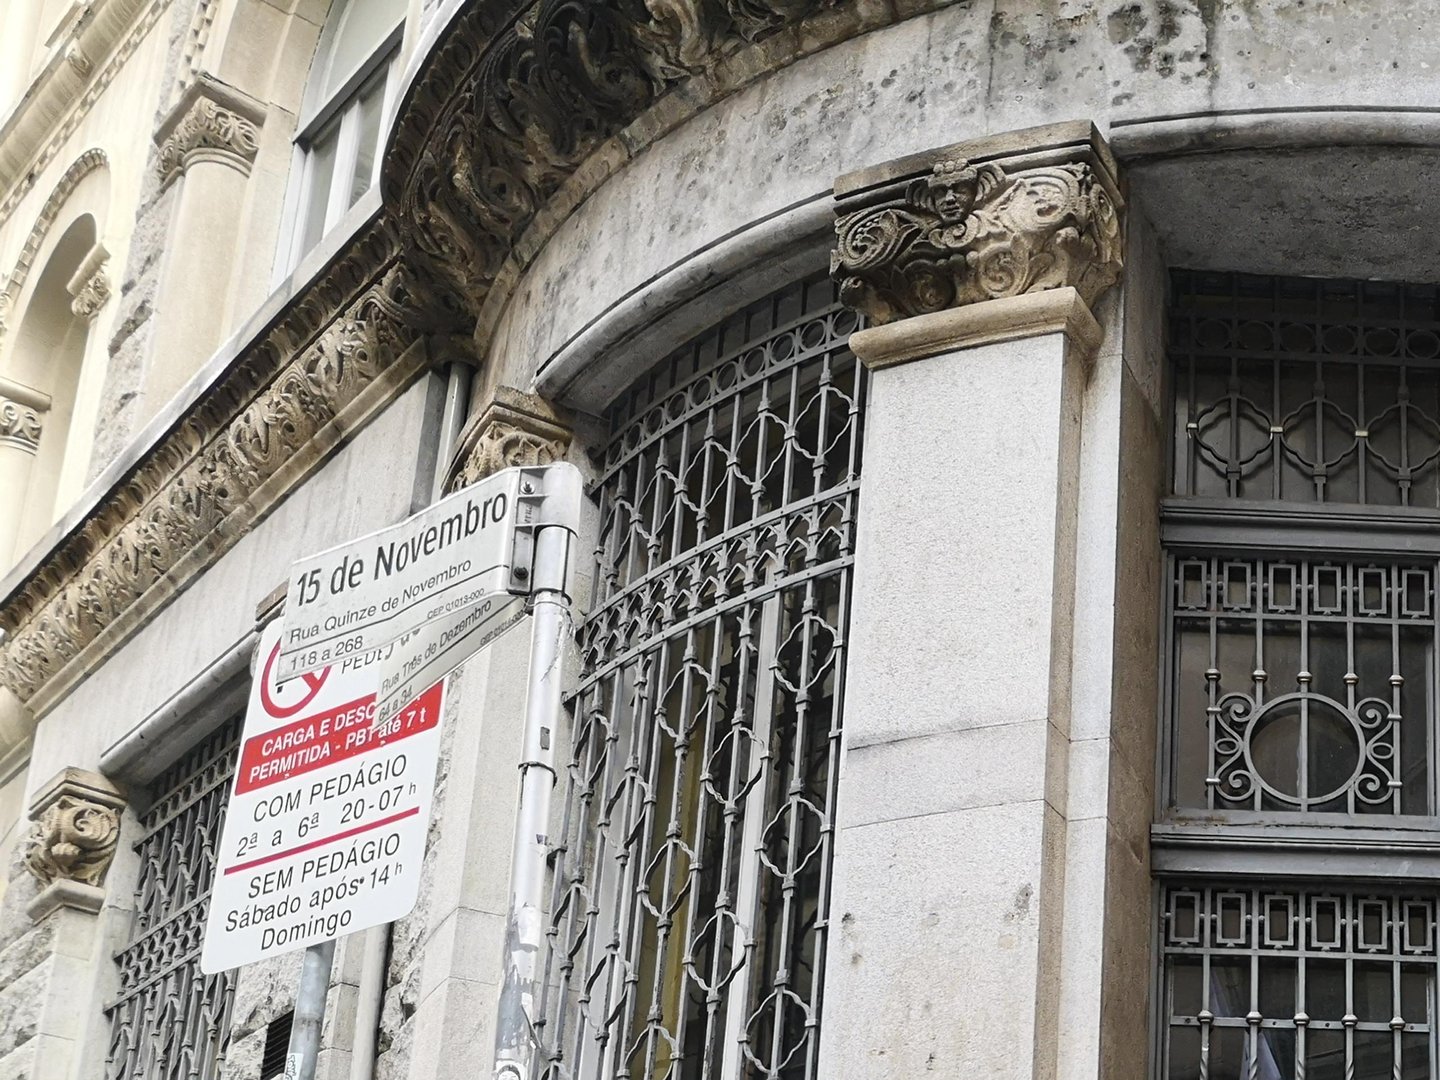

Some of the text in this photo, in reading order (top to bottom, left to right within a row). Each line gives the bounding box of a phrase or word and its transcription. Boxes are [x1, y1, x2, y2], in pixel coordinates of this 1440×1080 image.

[297, 568, 322, 607] 15
[330, 555, 364, 595] de
[373, 492, 507, 581] Novembro
[289, 559, 472, 645] Rua Quinze de Novembro
[427, 605, 444, 621] CEP
[290, 650, 317, 671] 118
[321, 650, 331, 661] a
[335, 635, 363, 657] 268
[381, 672, 400, 695] Rua
[402, 654, 423, 677] Três
[424, 642, 437, 660] de
[439, 600, 492, 649] Dezembro
[261, 722, 316, 757] CARGA
[319, 718, 331, 737] E
[378, 702, 391, 722] 64
[401, 685, 413, 706] 34
[249, 741, 331, 784] PERMITIDA
[378, 715, 402, 738] até
[406, 710, 417, 728] 7
[419, 707, 427, 724] t
[236, 832, 259, 858] 2ª
[271, 829, 282, 847] a
[298, 811, 320, 838] 6ª
[408, 782, 417, 796] h
[254, 754, 407, 823] COM PEDÁGIO
[225, 894, 301, 933] Sábado
[309, 875, 359, 911] após
[370, 864, 390, 890] 14
[248, 833, 400, 899] SEM PEDÁGIO
[261, 908, 352, 952] Domingo
